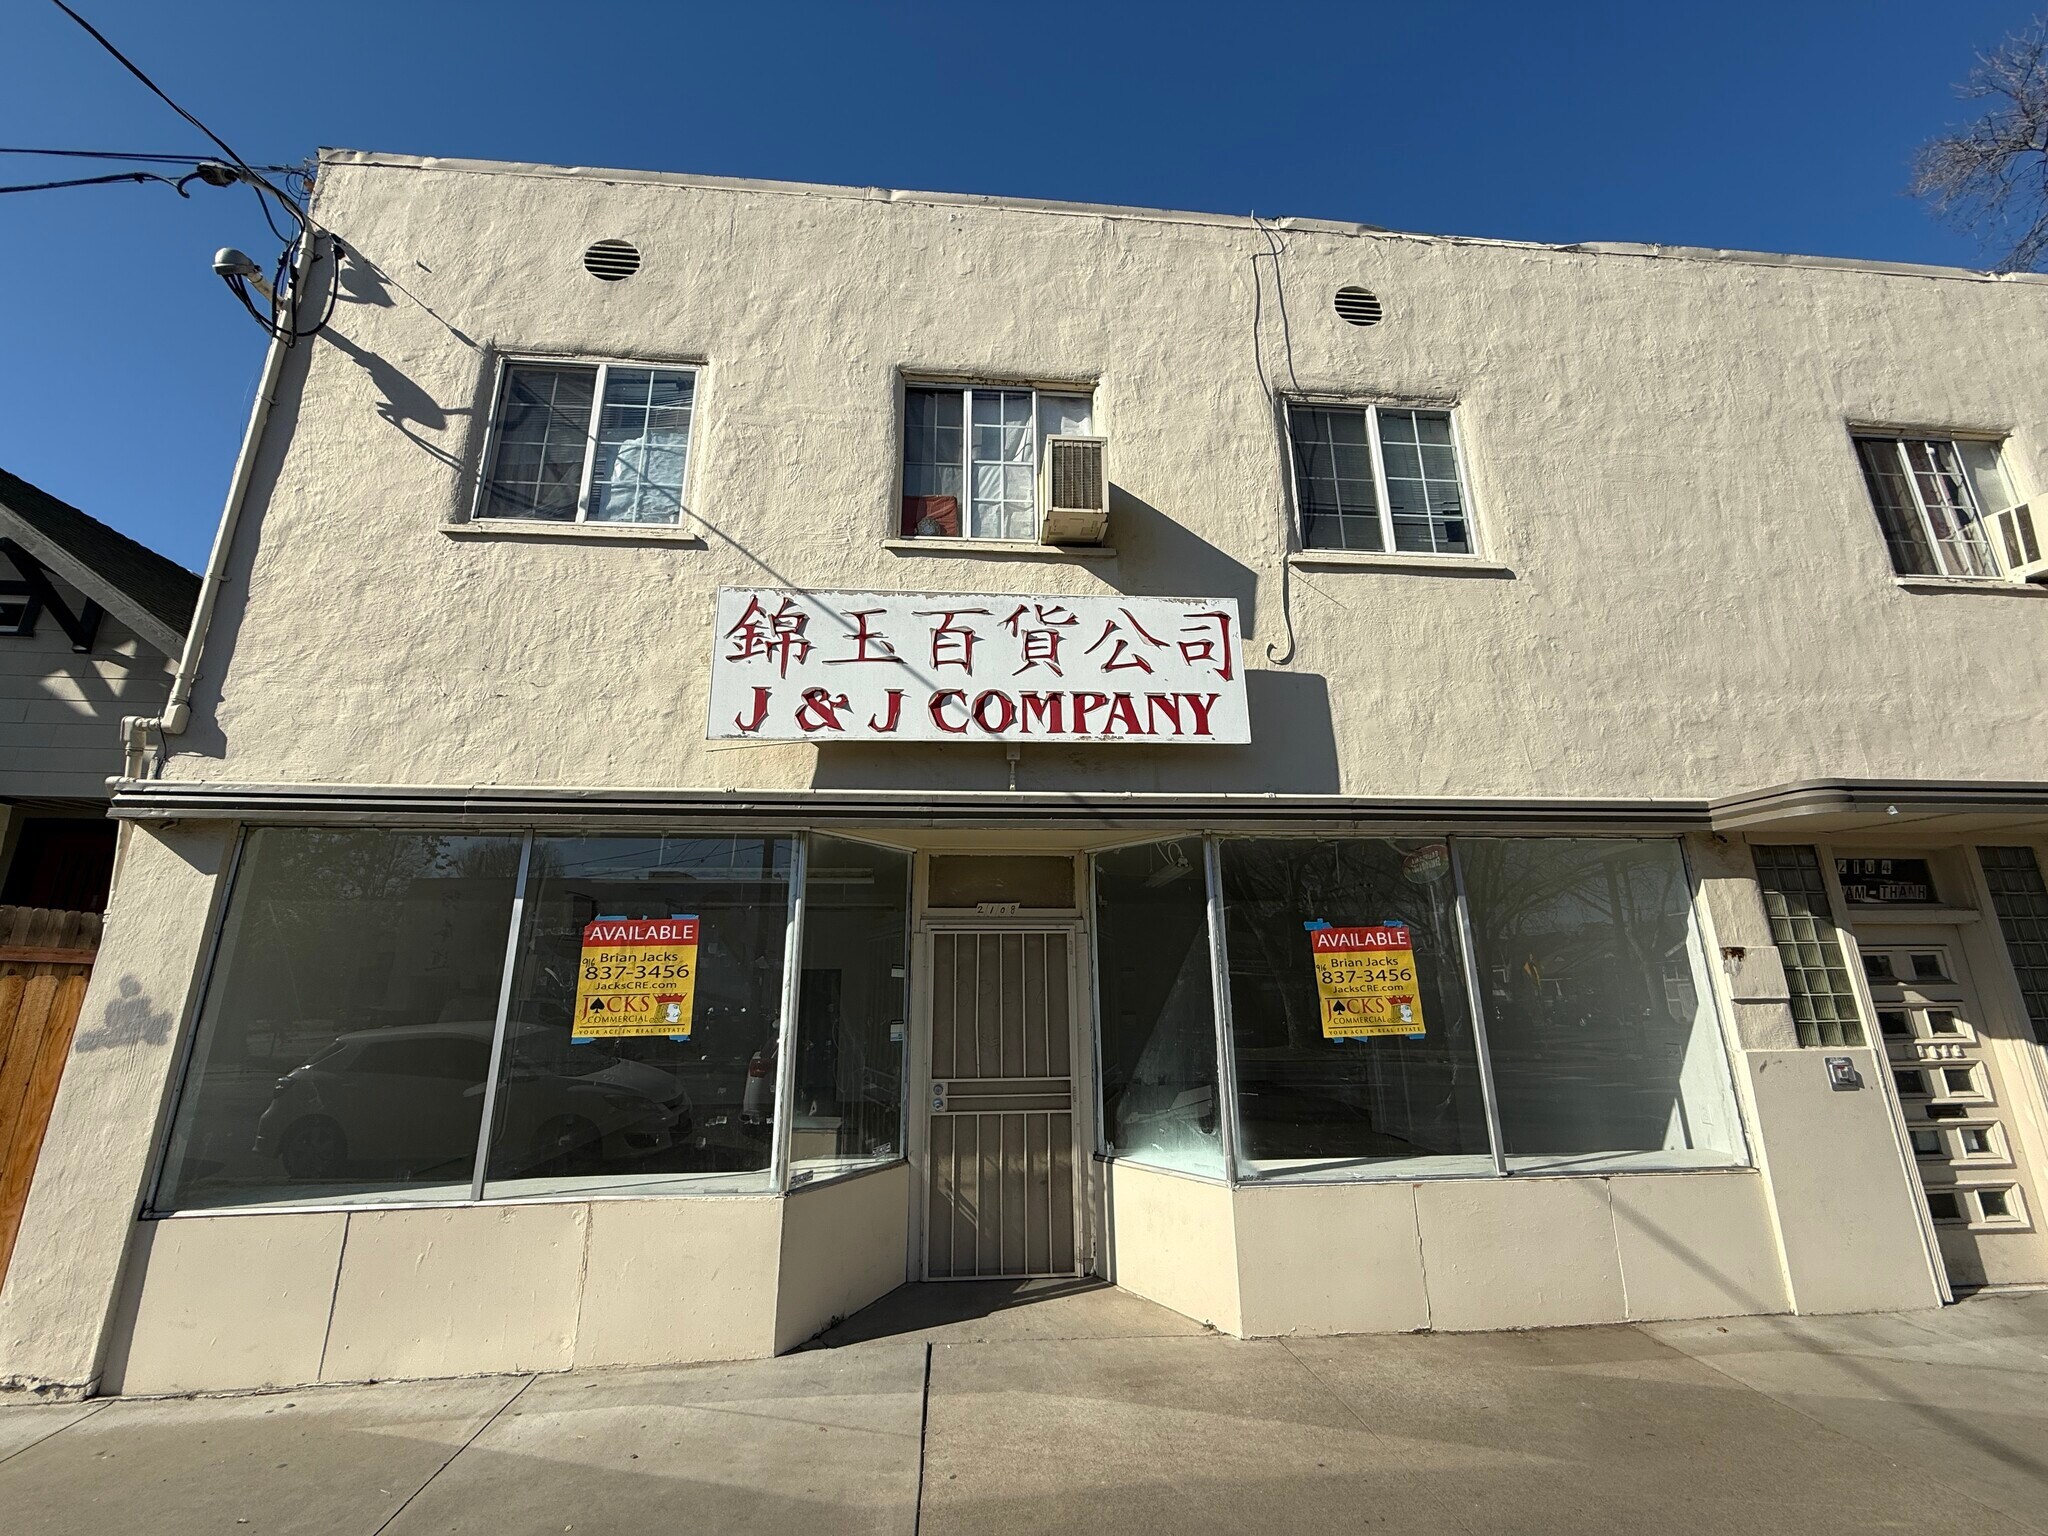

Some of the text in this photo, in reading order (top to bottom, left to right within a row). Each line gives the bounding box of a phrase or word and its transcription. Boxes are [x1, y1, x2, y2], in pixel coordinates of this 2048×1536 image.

[724, 595, 1234, 682] 錦玉百貨公司
[734, 686, 1222, 736] J & J COMPANY
[1838, 860, 1890, 874] 2104
[977, 905, 1016, 915] 2108
[590, 925, 694, 941] AVAILABLE
[1317, 931, 1407, 948] AVAILABLE
[582, 958, 596, 968] 916
[600, 952, 679, 963] Brian Jacks
[1331, 956, 1399, 968] Brian Jacks
[585, 964, 690, 980] 837-3456
[1316, 964, 1327, 973] 916
[1321, 968, 1412, 985] 837-3456
[595, 981, 677, 991] JacksCRE.com
[1332, 984, 1404, 994] JacksCRE.com
[587, 1015, 649, 1024] COMMERCIAL
[1333, 1016, 1387, 1025] COMMERCIAL
